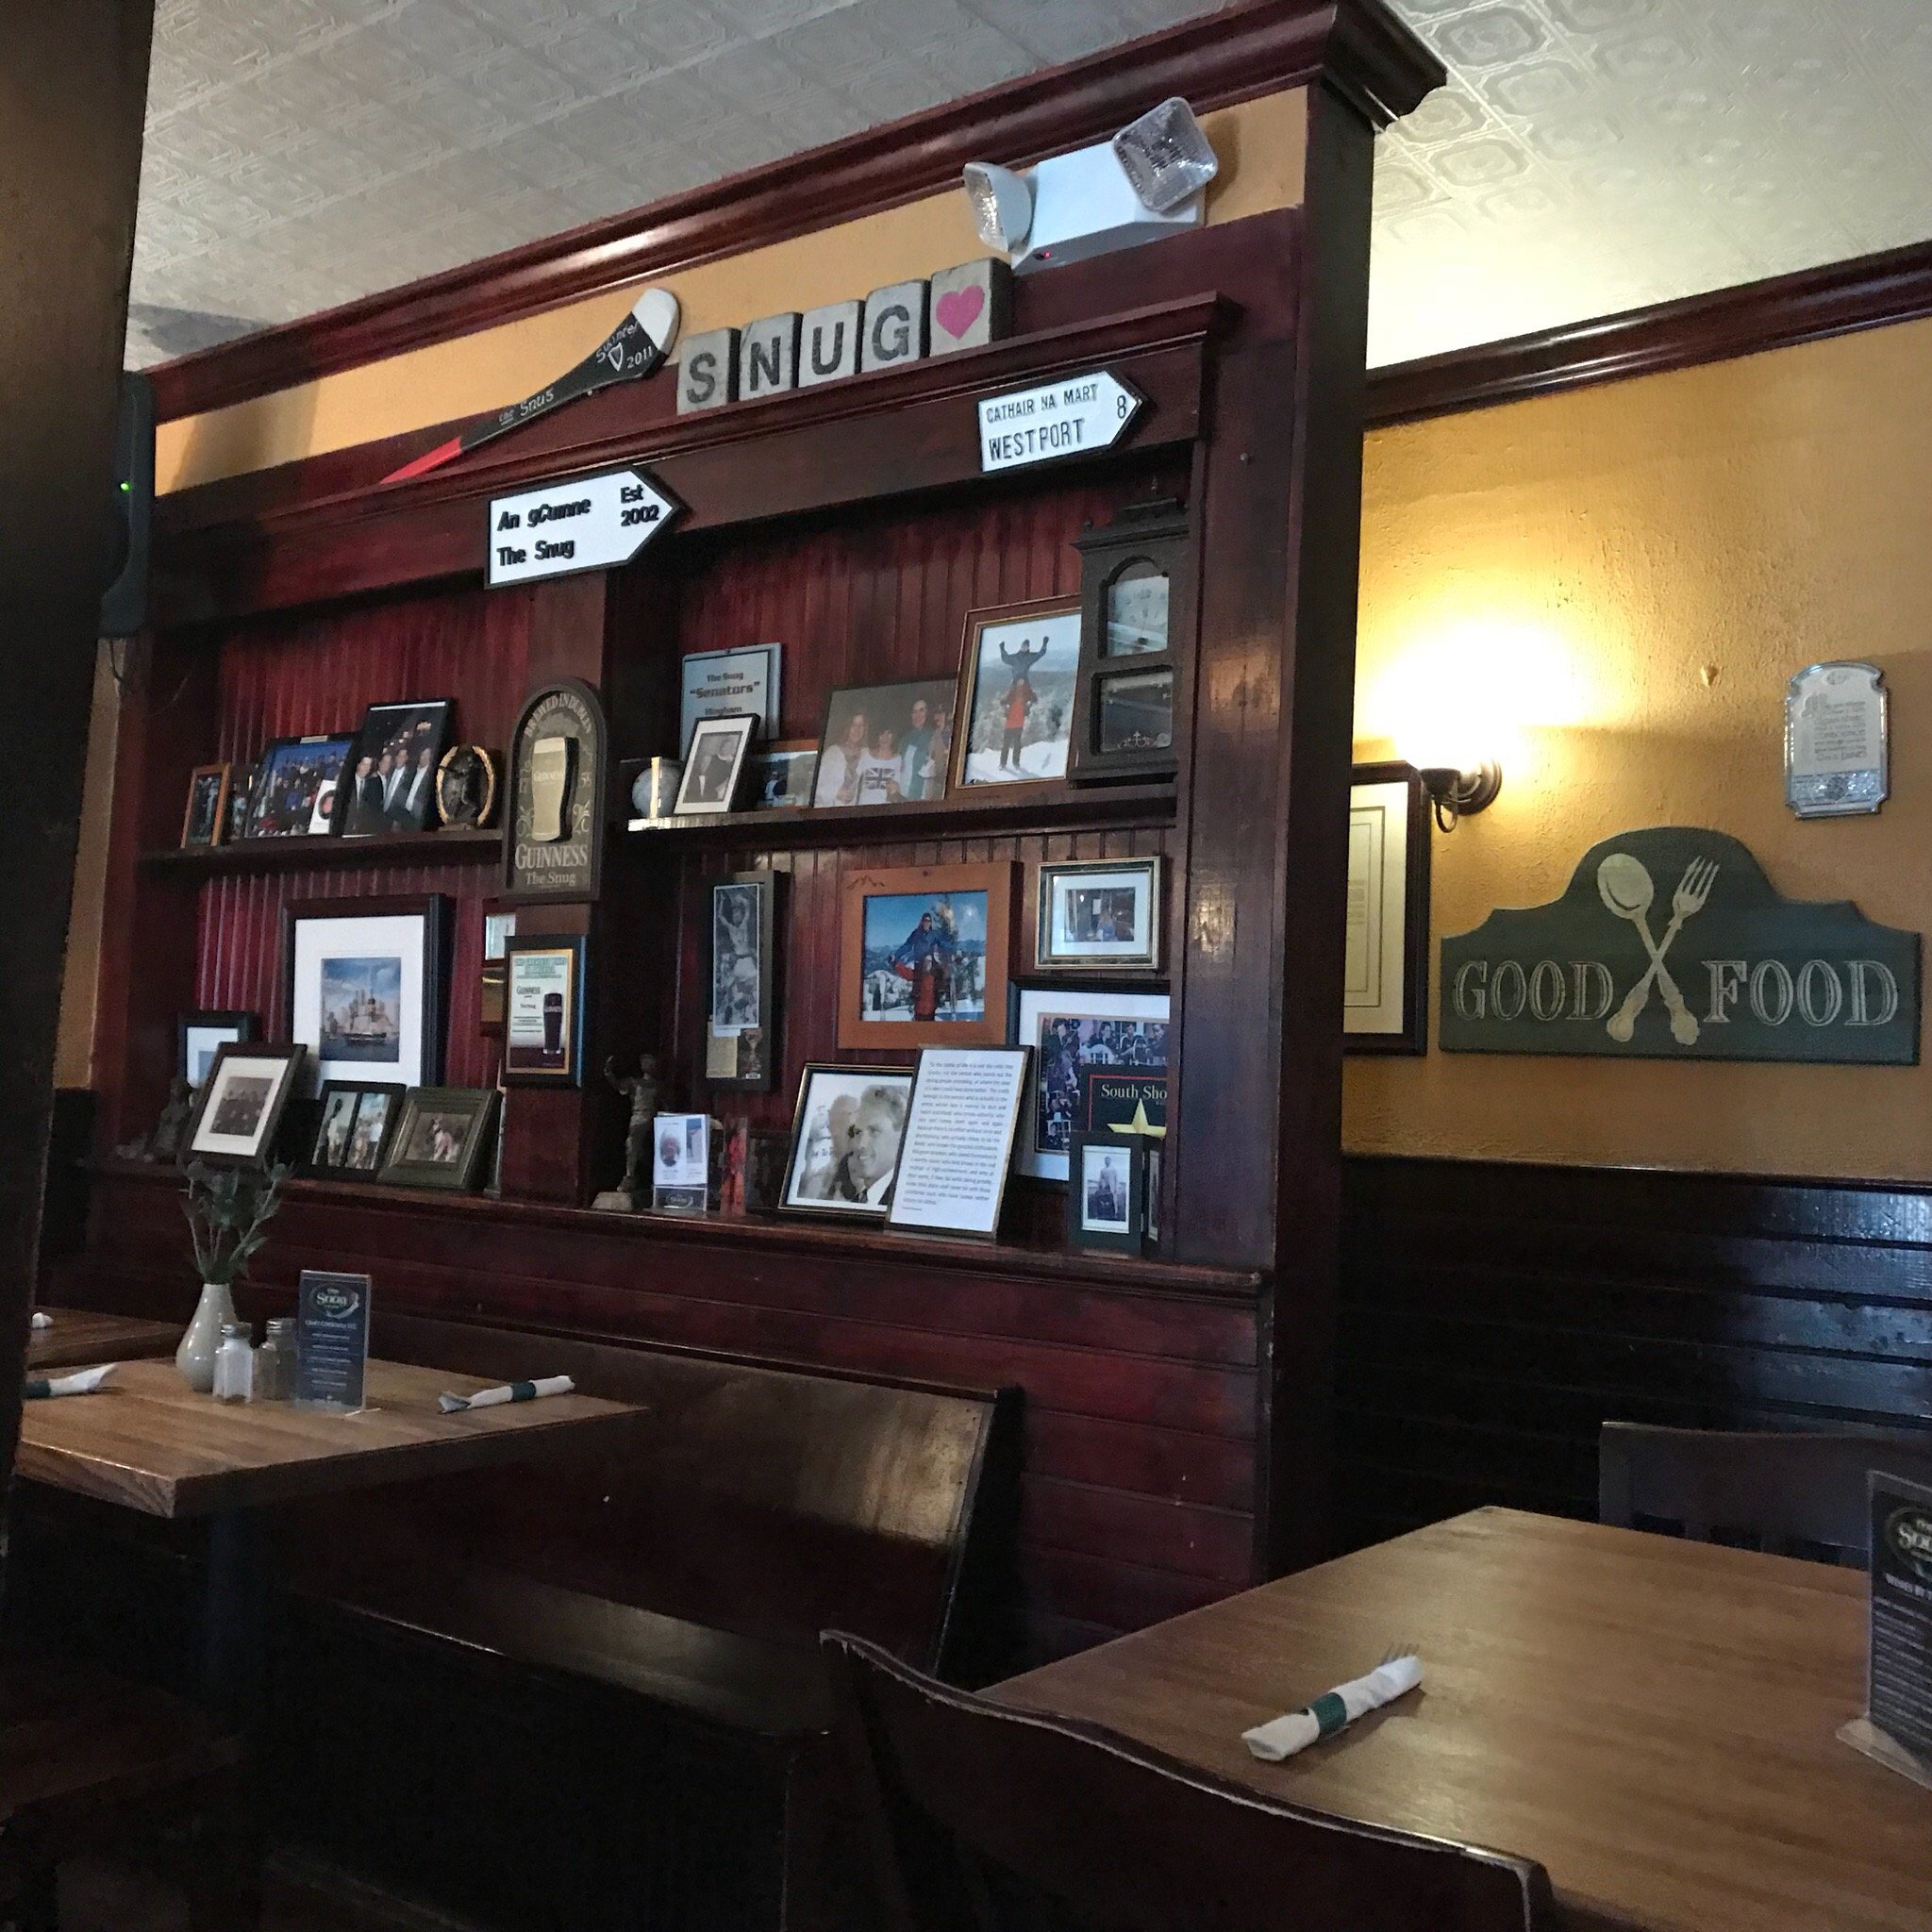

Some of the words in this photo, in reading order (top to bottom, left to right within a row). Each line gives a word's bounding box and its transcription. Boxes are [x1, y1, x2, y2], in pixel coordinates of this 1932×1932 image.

[626, 345, 653, 369] 2011
[686, 305, 909, 404] SNUG
[986, 398, 1036, 424] CATHAIR
[1041, 393, 1057, 410] NA
[1063, 383, 1099, 405] MART
[1116, 394, 1127, 420] 8
[989, 418, 1085, 461] WESTPORT
[620, 484, 643, 504] Est
[496, 510, 520, 531] An
[620, 504, 659, 526] 2002
[496, 546, 526, 566] The
[534, 540, 575, 559] Snug
[707, 674, 722, 683] The
[558, 692, 570, 708] IN
[515, 844, 588, 870] GUINNESS
[525, 872, 546, 886] The
[548, 872, 575, 887] Snug
[1452, 958, 1614, 1022] GOOD
[1701, 958, 1899, 1027] FOOD
[1101, 1083, 1139, 1098] South
[1142, 1085, 1167, 1100] Sho
